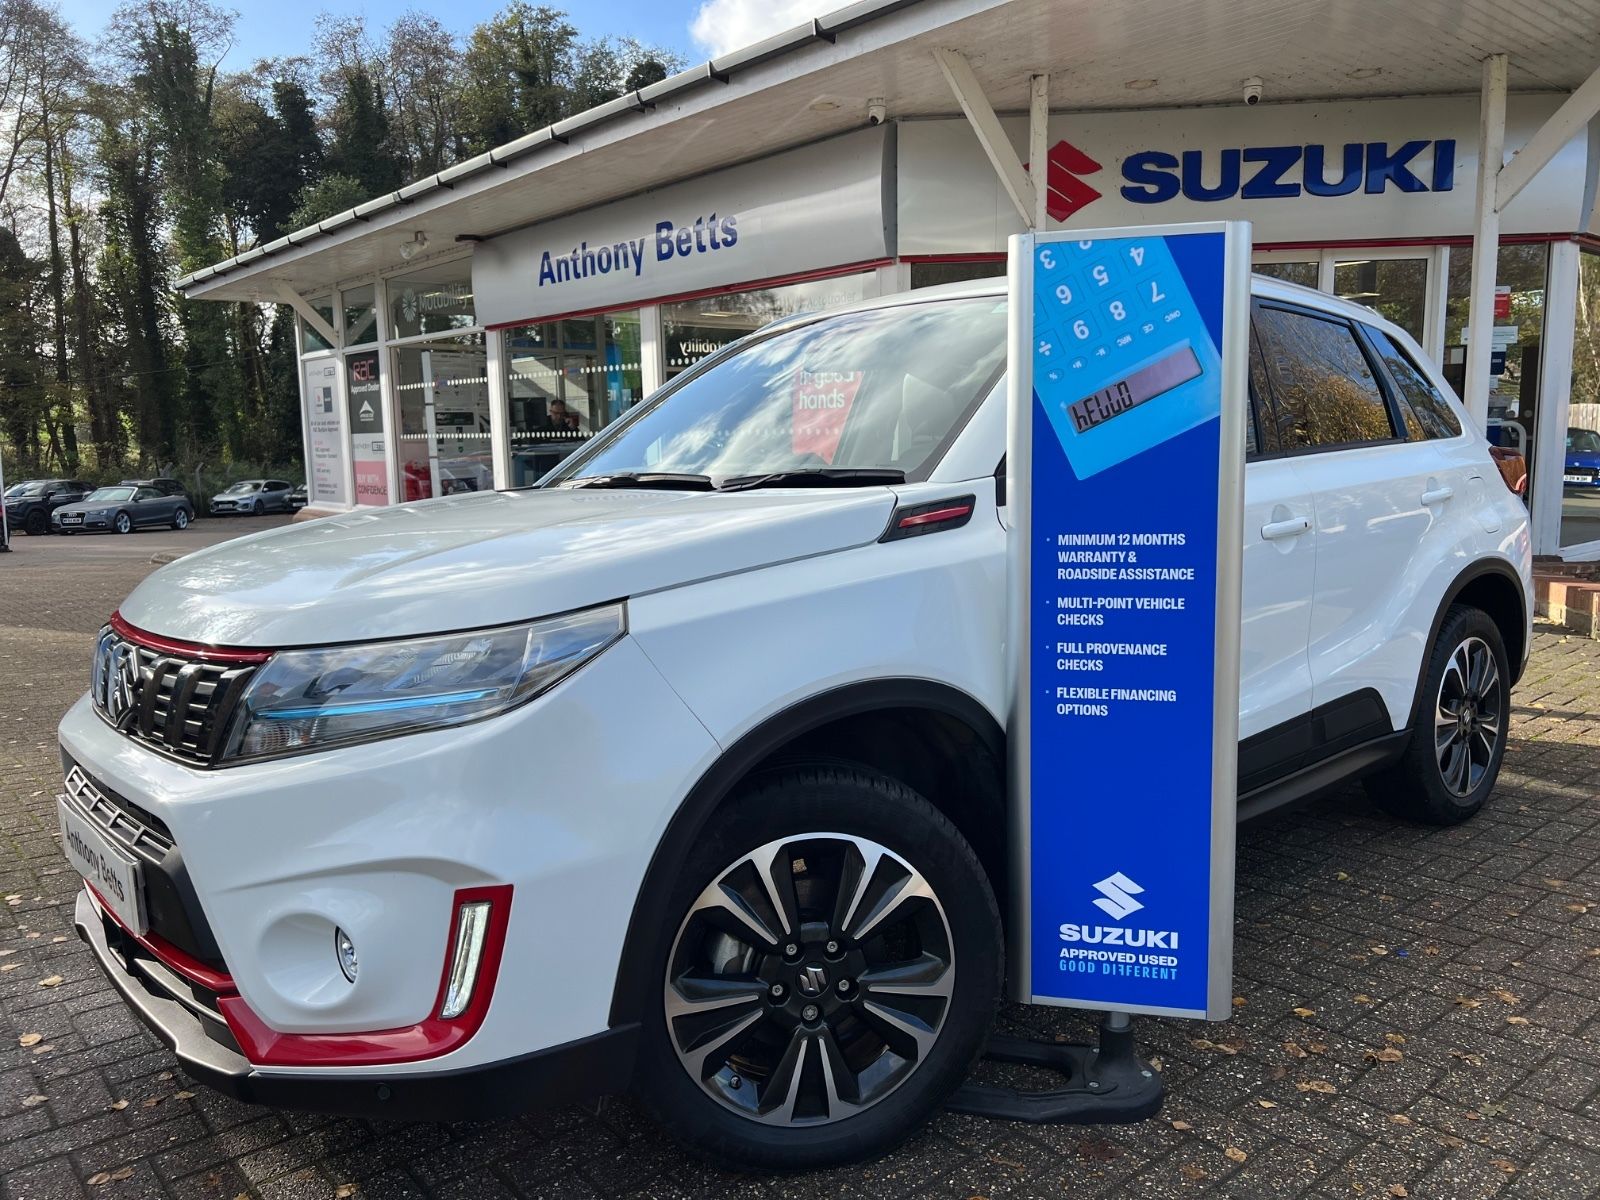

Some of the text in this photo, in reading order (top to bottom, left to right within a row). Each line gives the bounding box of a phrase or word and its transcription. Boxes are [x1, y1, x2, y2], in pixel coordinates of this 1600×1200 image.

[1120, 139, 1456, 204] SUZUKI
[538, 212, 738, 287] Anthony Betts
[1040, 249, 1056, 269] 3
[1055, 246, 1145, 305] 4 5 6
[1151, 281, 1165, 303] 7
[1109, 300, 1126, 321] 8
[1073, 319, 1090, 340] 9
[353, 360, 375, 381] RAC
[799, 388, 845, 410] hands
[1058, 533, 1186, 546] MINIMUM 12 MONTHS
[1058, 551, 1137, 563] WARRANTY &
[1057, 568, 1195, 581] ROADSIDE ASSISTANCE
[1057, 597, 1185, 610] MULTI-POINT VEHICLE
[1057, 614, 1104, 626] CHECKS
[1057, 643, 1168, 656] FULL PROVENANCE
[1056, 659, 1103, 671] CHECKS
[1056, 687, 1177, 702] FLEXIBLE FINANCING
[1056, 703, 1108, 716] OPTIONS
[65, 821, 126, 902] Anthony Betts
[1059, 923, 1179, 950] SUZUKI
[1060, 948, 1178, 967] APPROVED USED
[1059, 959, 1178, 980] GOOD DIFFERENT
